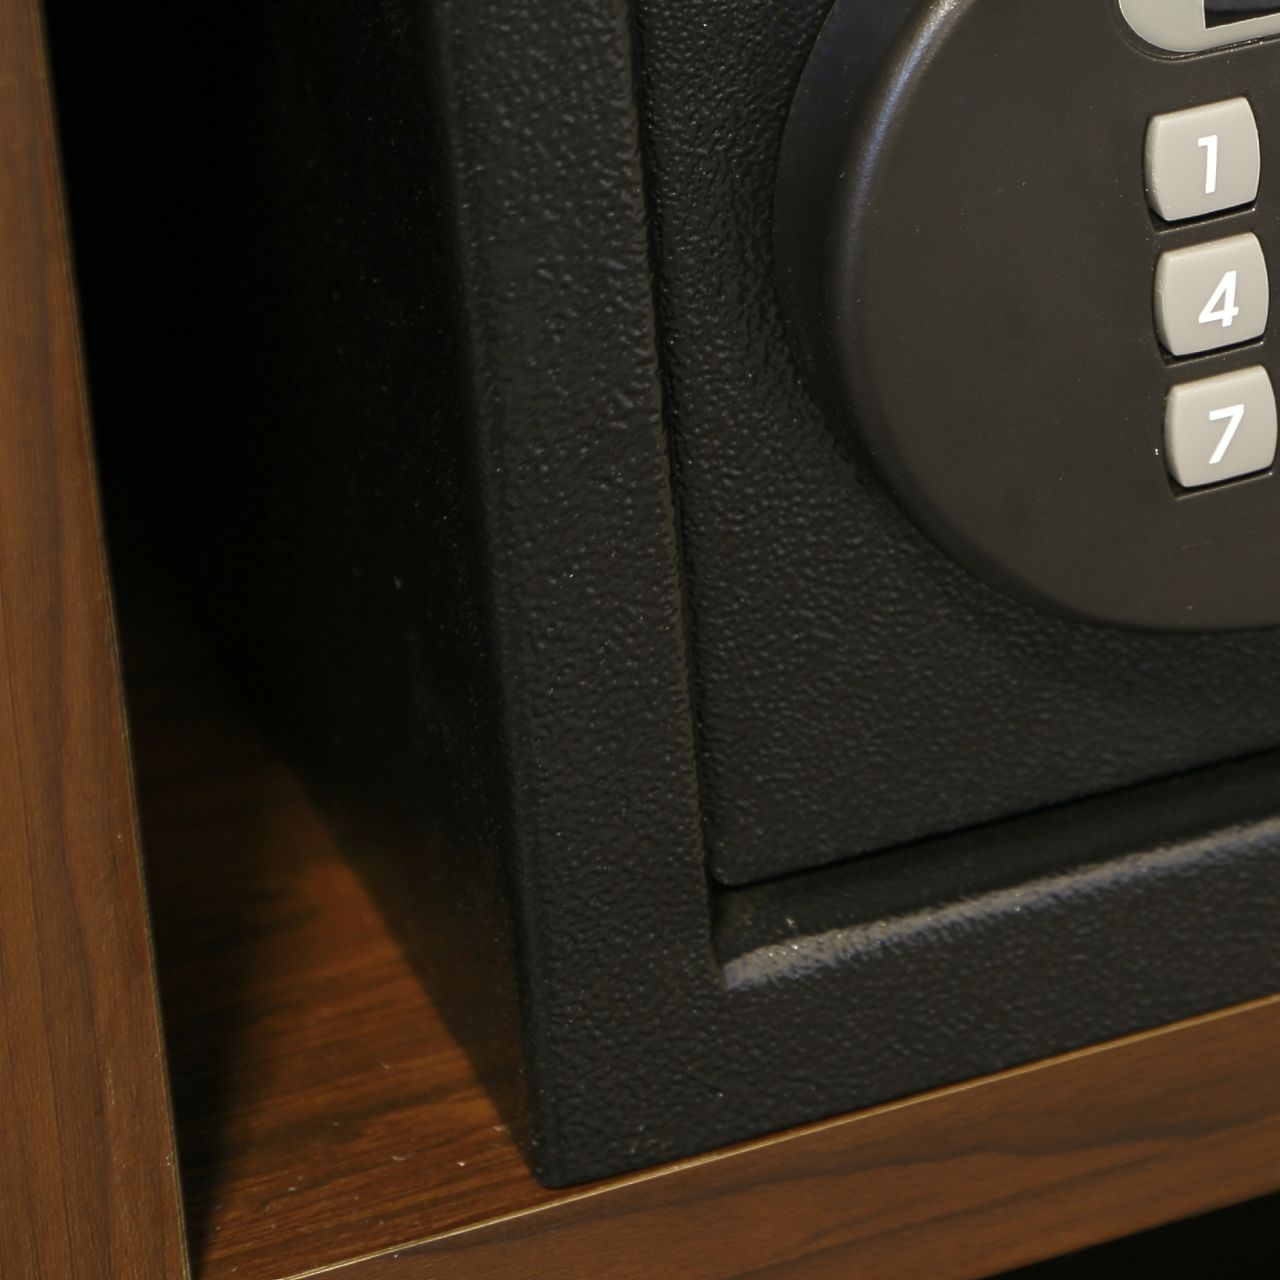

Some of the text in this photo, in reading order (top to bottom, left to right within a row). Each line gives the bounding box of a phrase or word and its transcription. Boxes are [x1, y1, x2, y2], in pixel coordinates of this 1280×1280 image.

[1197, 134, 1218, 194] 1
[1198, 270, 1239, 328] 4
[1208, 404, 1244, 465] 7
